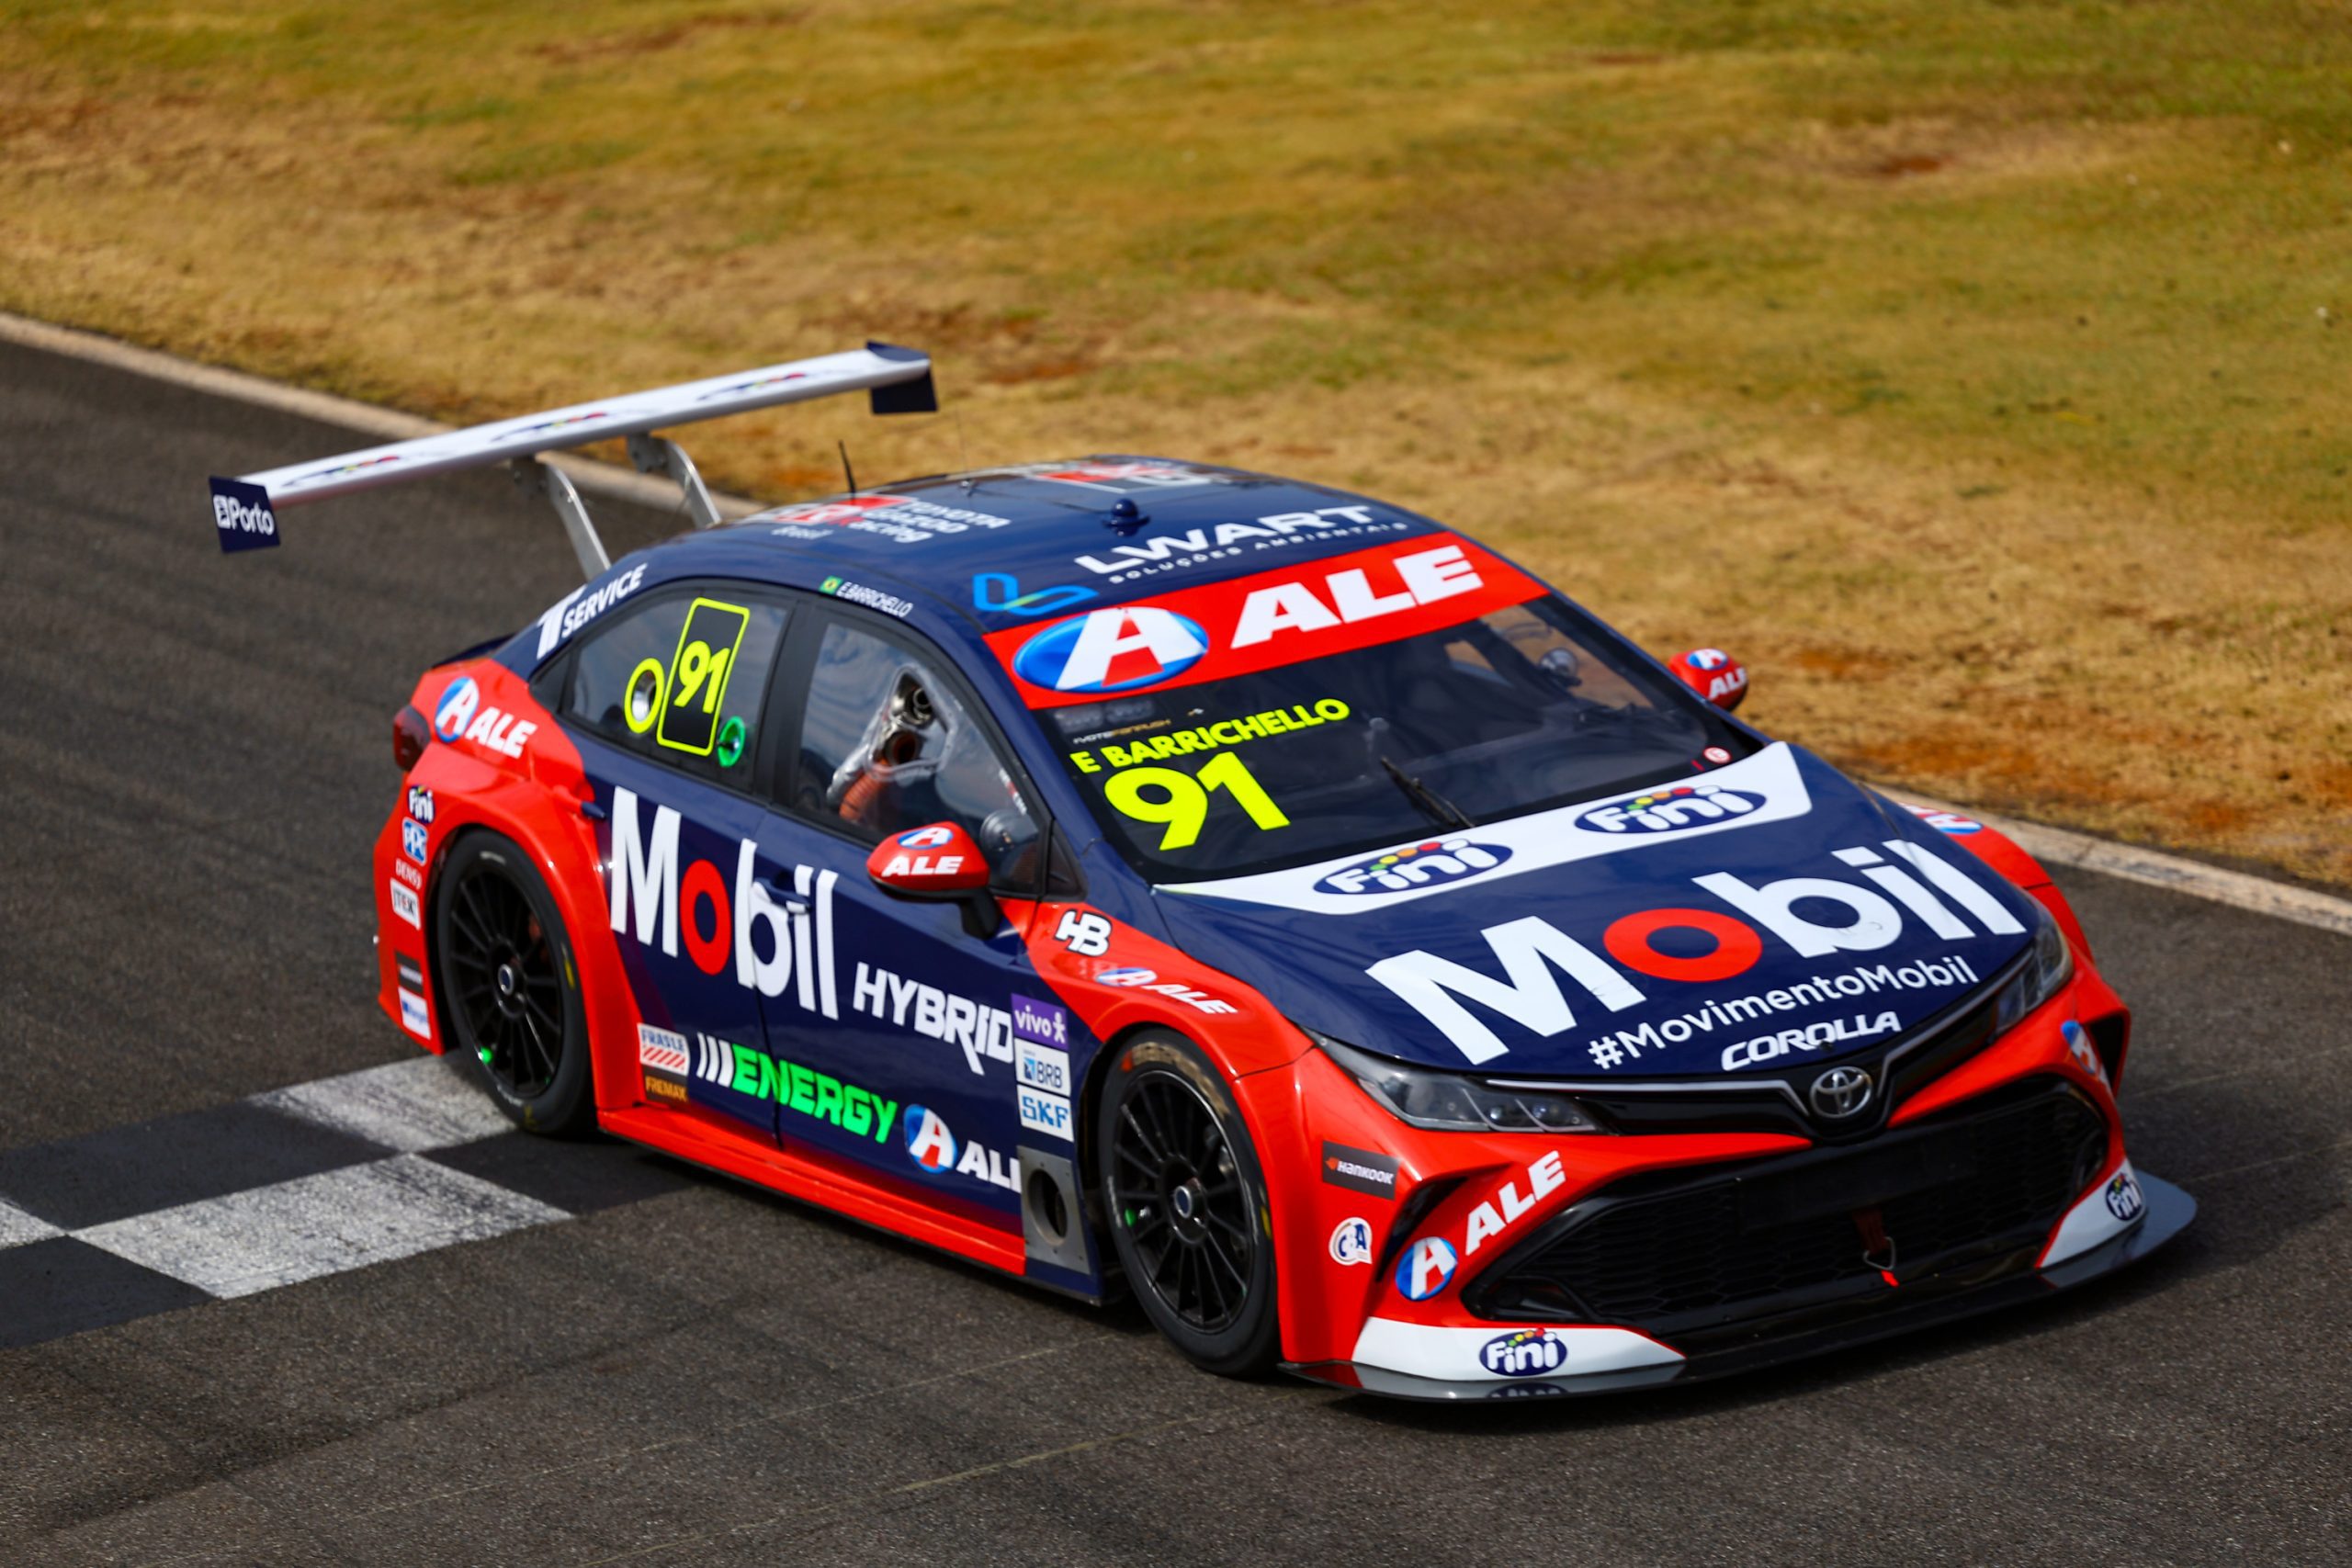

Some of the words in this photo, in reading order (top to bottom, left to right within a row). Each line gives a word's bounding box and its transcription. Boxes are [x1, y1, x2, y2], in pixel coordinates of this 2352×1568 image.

[1074, 505, 1374, 574] LWART
[1254, 522, 1408, 551] AMBIENTAIS
[561, 563, 648, 638] SERVICE
[1229, 544, 1486, 650] ALE
[674, 640, 730, 715] 91
[465, 705, 538, 760] ALE
[1069, 750, 1102, 773] E
[1101, 698, 1351, 769] BARRICHELLO
[1104, 750, 1291, 852] 91
[610, 785, 839, 1021] Mobil
[880, 856, 965, 877] ALE
[1363, 839, 2027, 1065] Mobil
[853, 962, 1014, 1077] HYBRID
[1014, 1004, 1052, 1037] vivo
[1141, 984, 1238, 1014] ALE
[1588, 955, 1980, 1070] #MovimentoMobil
[1036, 1061, 1063, 1089] BRB
[1721, 1011, 1902, 1072] COROLLA
[732, 1043, 898, 1145] ENERGY
[1022, 1096, 1069, 1129] SKF
[1465, 1150, 1566, 1257] ALE
[1487, 1331, 1560, 1374] Fini
